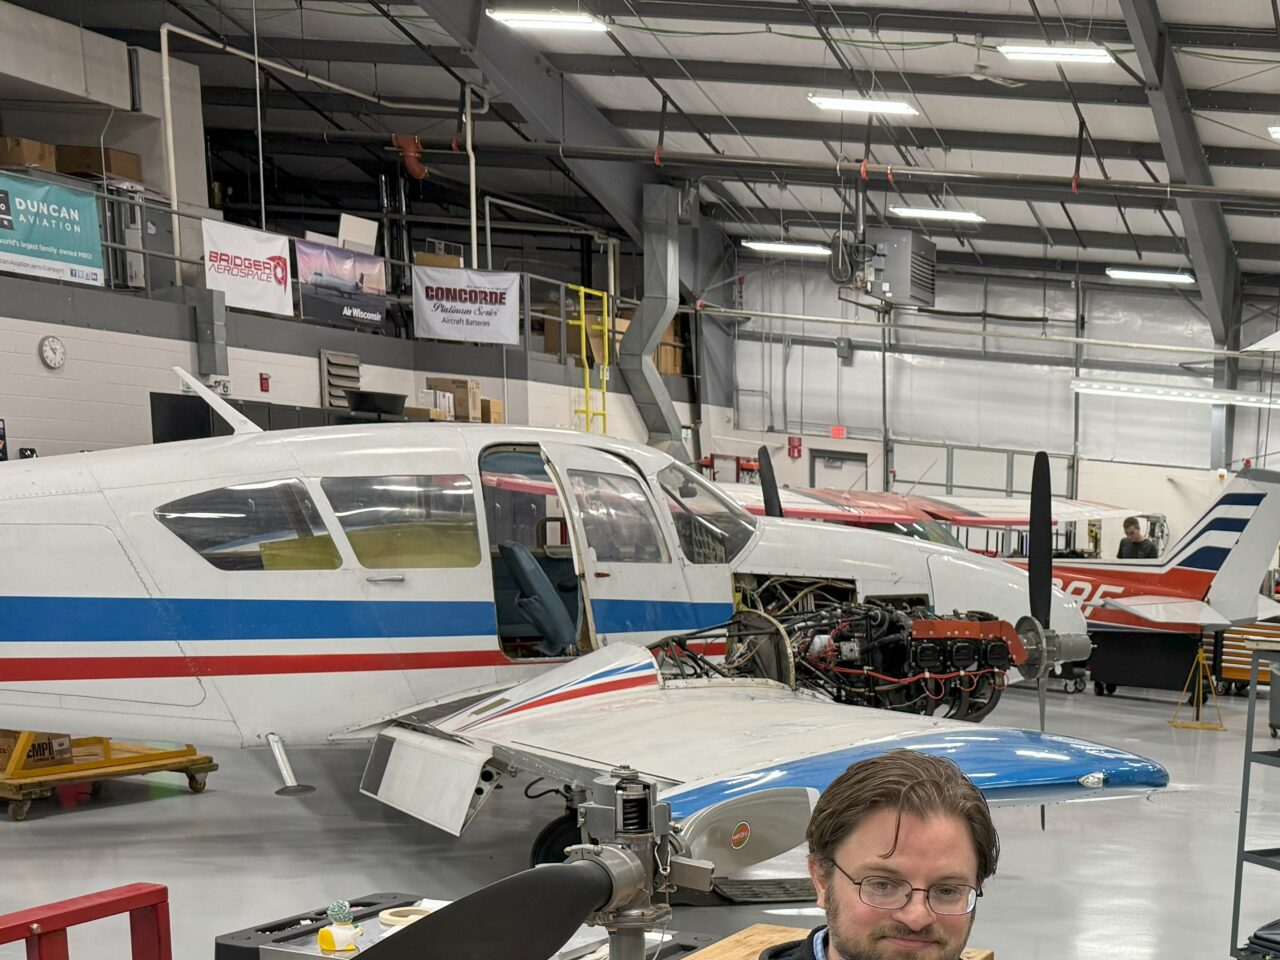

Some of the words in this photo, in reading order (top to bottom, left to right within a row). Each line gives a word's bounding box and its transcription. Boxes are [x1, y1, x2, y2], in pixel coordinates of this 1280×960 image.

[15, 197, 80, 221] DUNCAN
[19, 214, 81, 233] AVIATION
[39, 244, 57, 254] family
[58, 248, 77, 257] owned
[208, 251, 272, 273] BRIDGER
[208, 263, 272, 282] AEROSPACE
[424, 286, 507, 306] CONCORDE
[431, 303, 472, 315] Platinum
[473, 307, 499, 317] Series
[441, 317, 464, 326] Aircraft
[465, 319, 490, 327] Batteries
